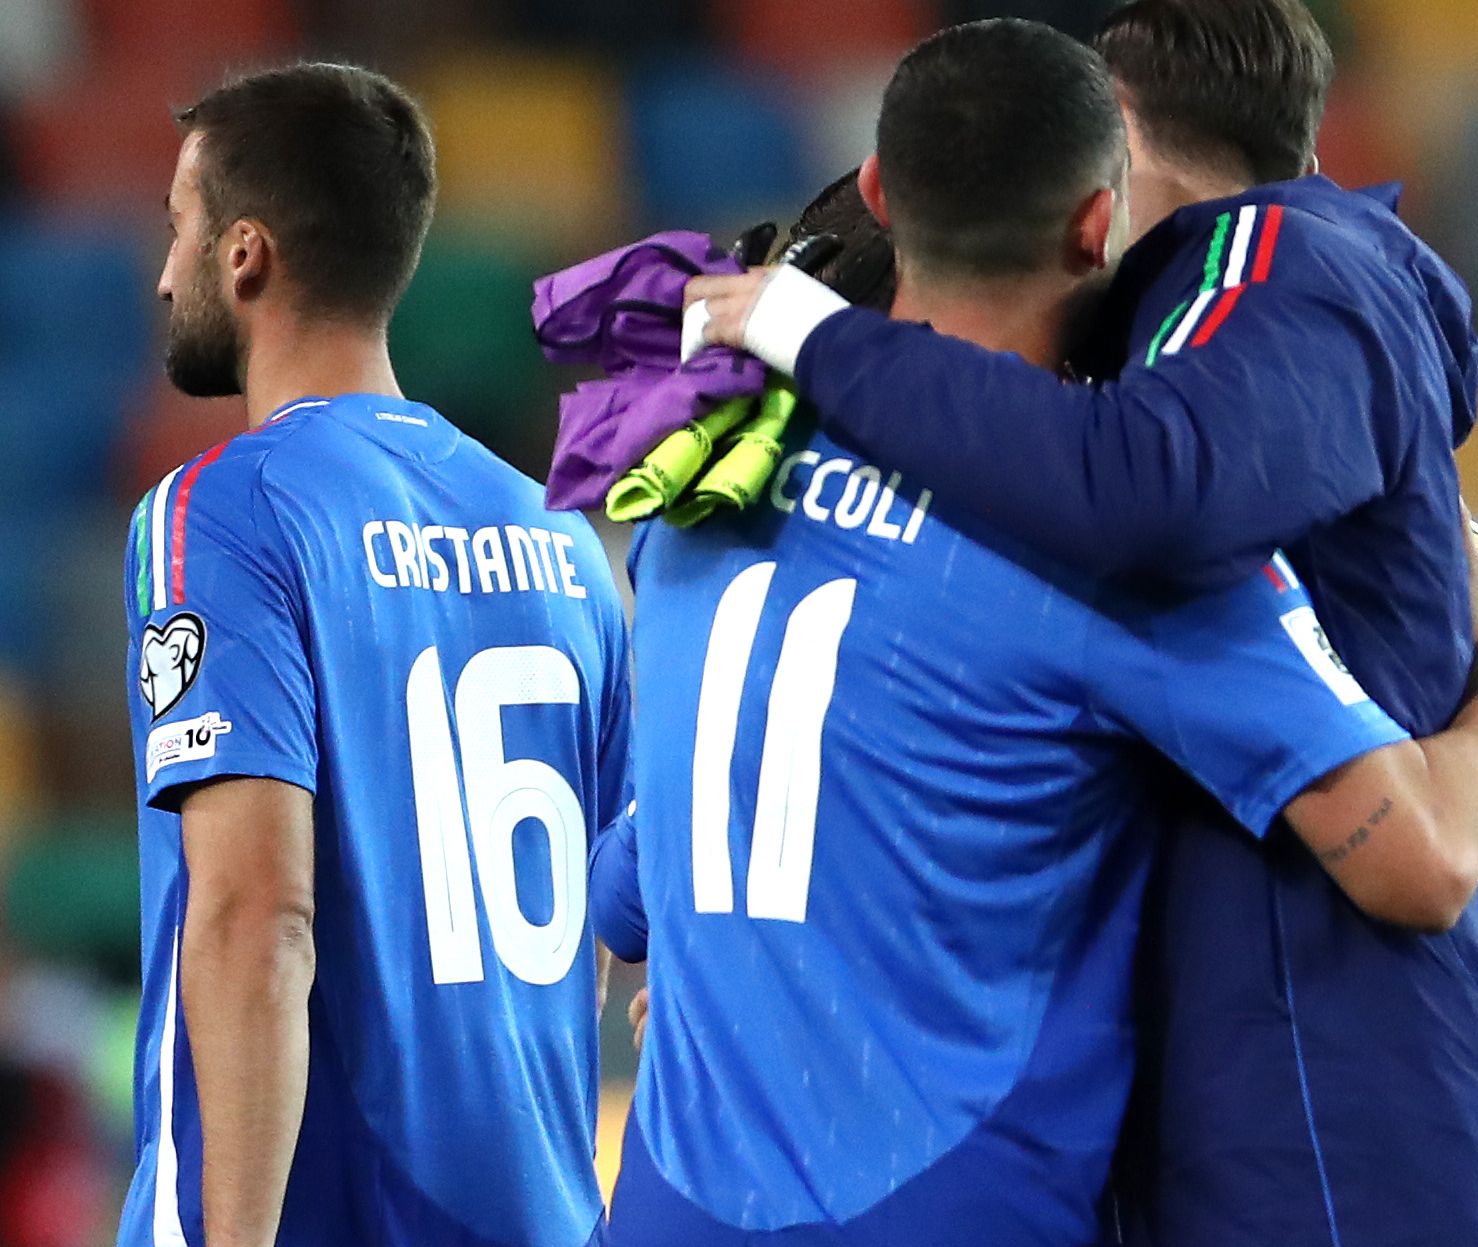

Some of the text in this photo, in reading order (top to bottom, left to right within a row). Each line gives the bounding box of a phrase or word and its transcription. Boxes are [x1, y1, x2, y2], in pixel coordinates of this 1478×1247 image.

[363, 520, 587, 599] CRISTANTE
[770, 450, 933, 544] CCOLI
[406, 645, 587, 986] 16
[691, 561, 857, 924] 11
